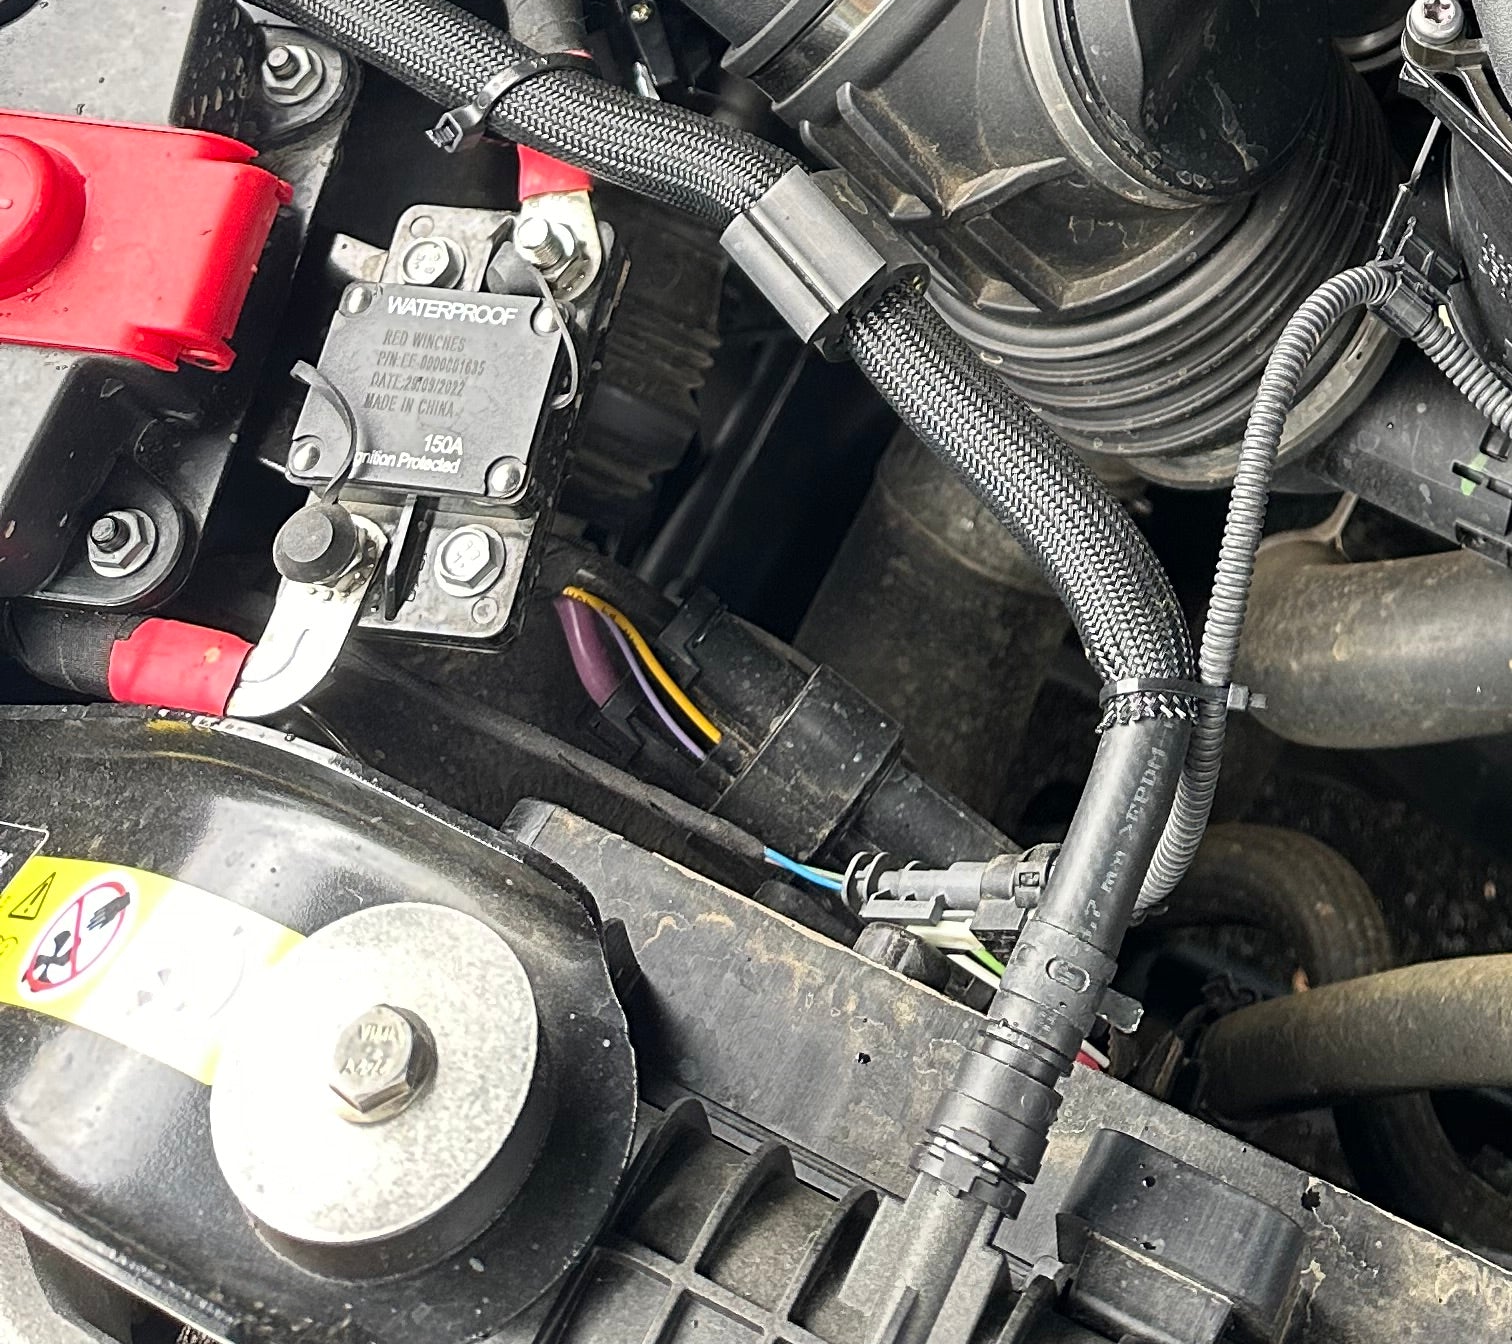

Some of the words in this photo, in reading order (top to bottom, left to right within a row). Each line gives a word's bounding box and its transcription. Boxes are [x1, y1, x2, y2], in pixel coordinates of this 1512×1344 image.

[388, 297, 518, 325] WATERPROOF
[383, 328, 407, 348] RED
[411, 333, 466, 352] WINCHES
[364, 391, 398, 413] MADE
[399, 397, 415, 414] IN
[418, 399, 454, 418] CHINA
[423, 433, 464, 456] 150A
[354, 451, 395, 470] gnition
[397, 453, 460, 474] Protected
